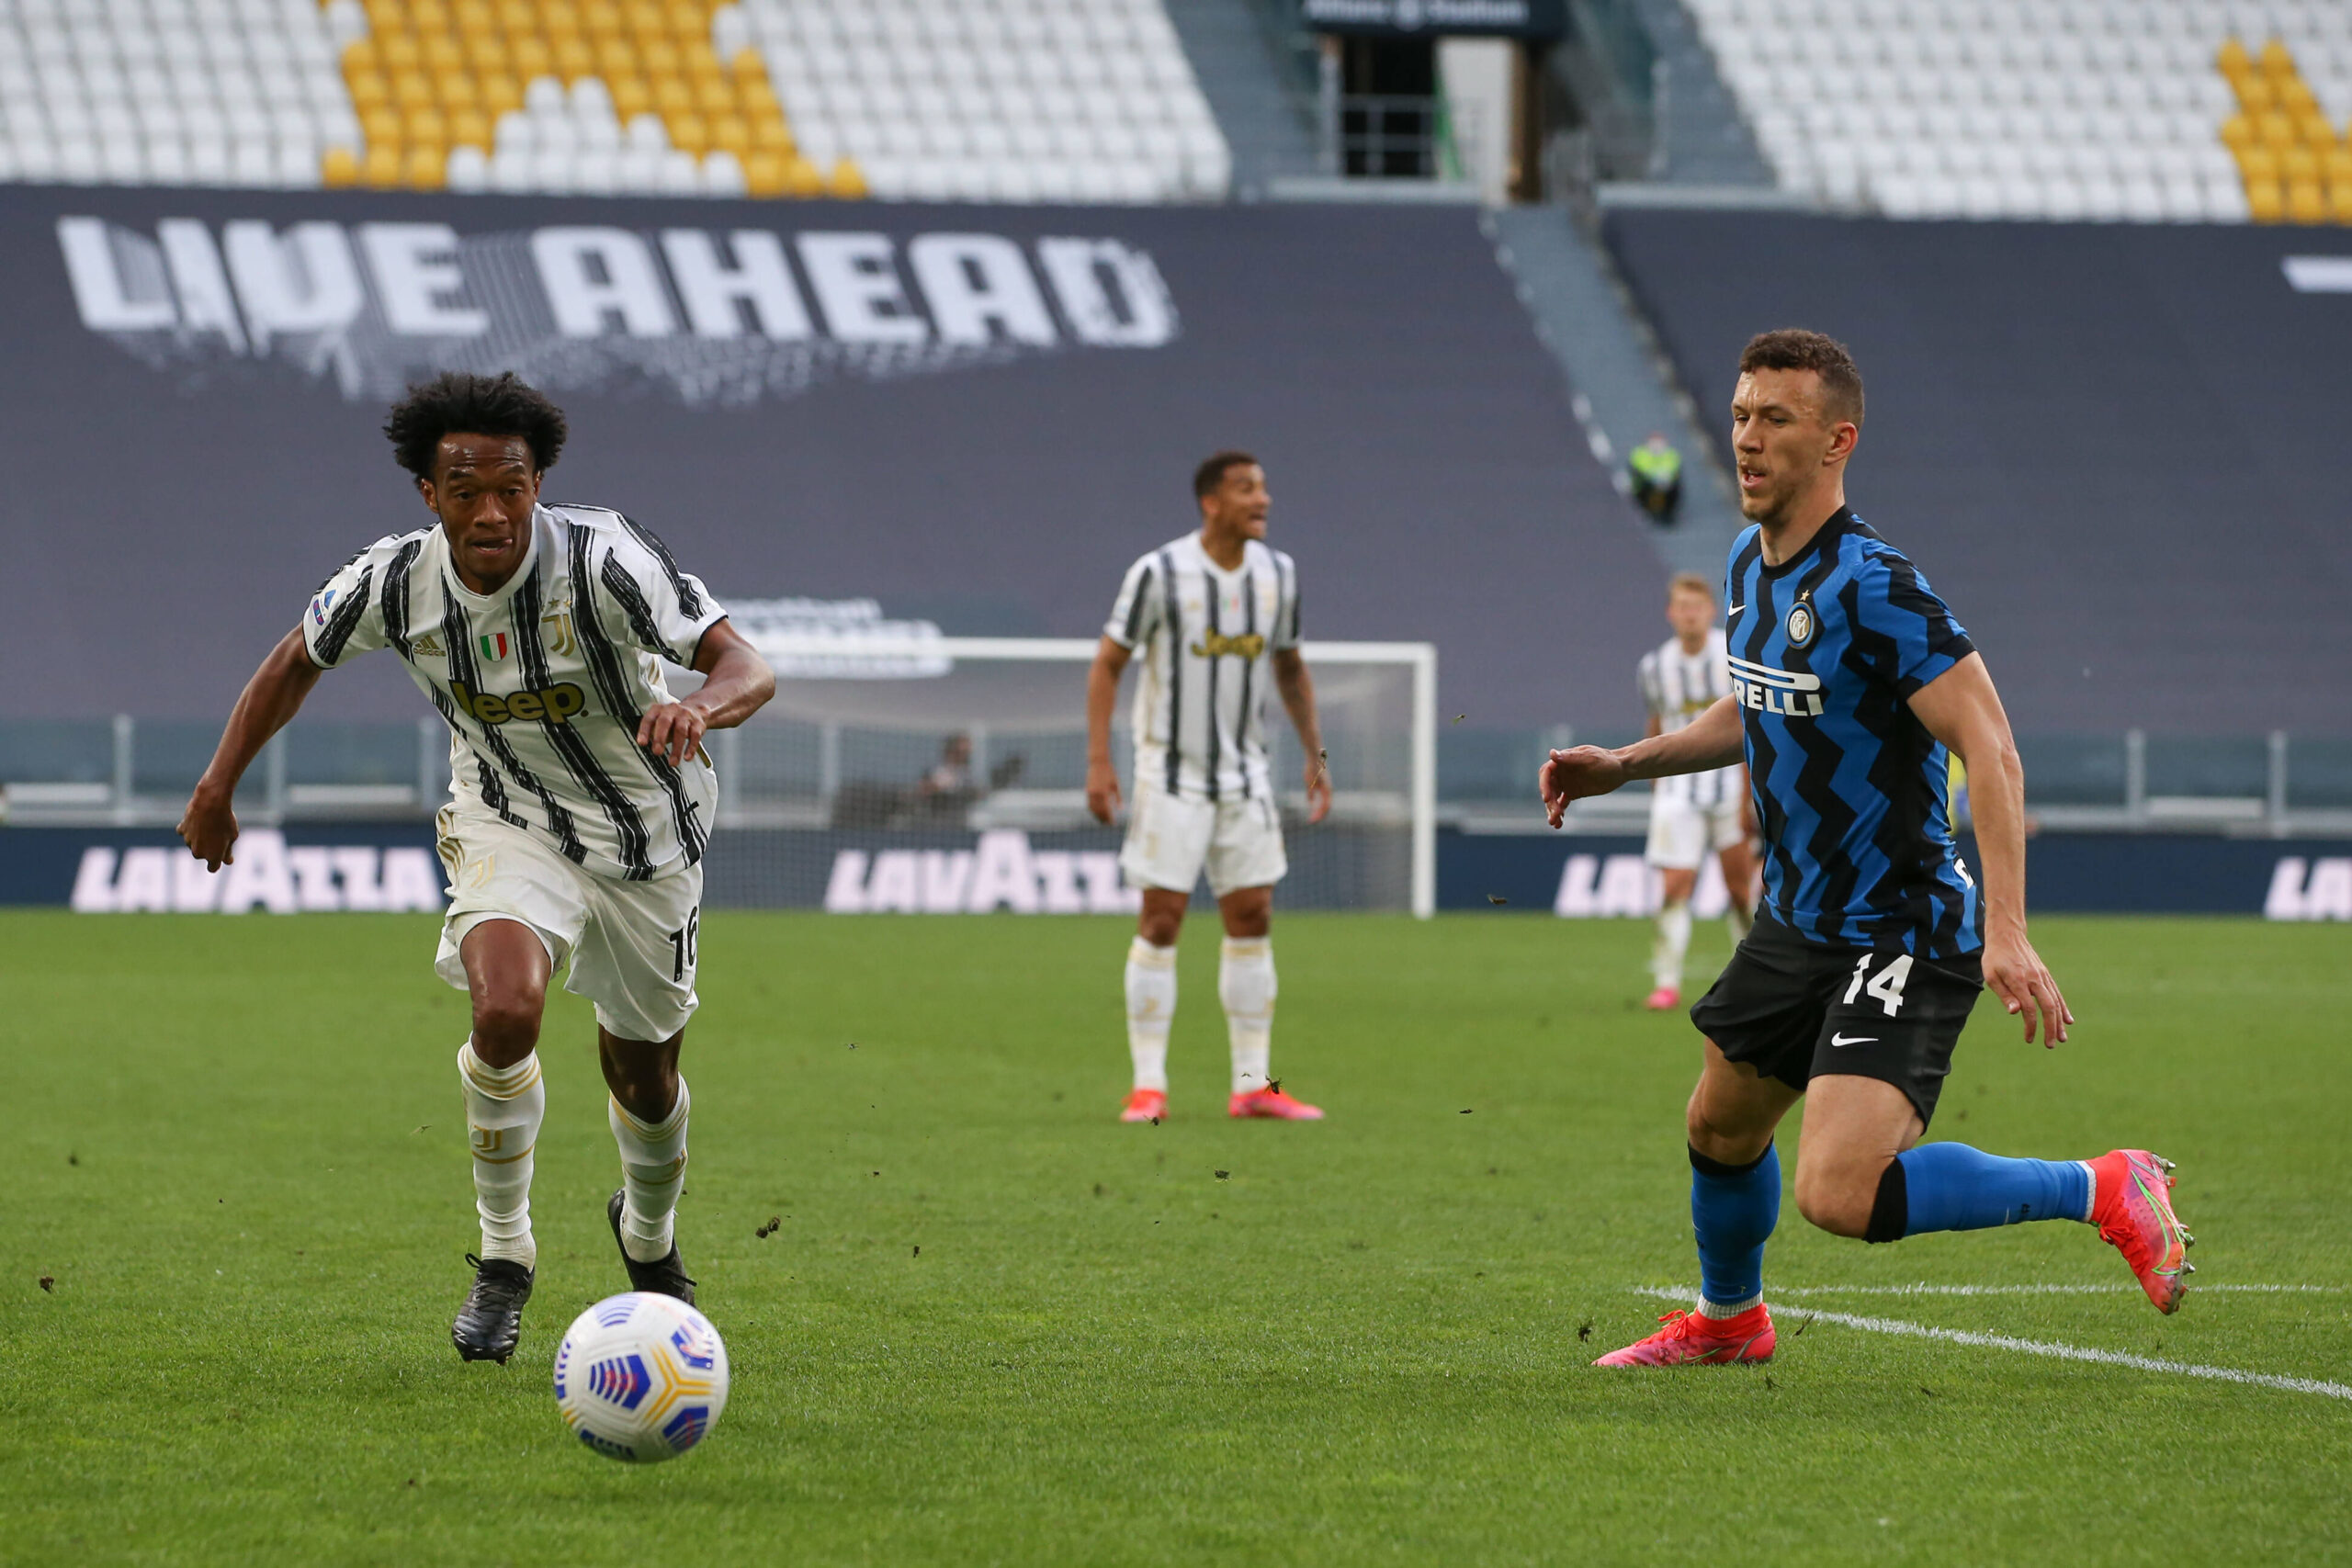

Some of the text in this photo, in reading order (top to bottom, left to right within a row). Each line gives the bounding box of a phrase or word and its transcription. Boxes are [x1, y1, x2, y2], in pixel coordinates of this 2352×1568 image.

[55, 216, 1182, 356] LIVE AHEAD
[413, 647, 447, 658] adidas
[448, 679, 585, 725] Jeep
[71, 828, 443, 914] LAVAZZA
[824, 829, 1143, 914] LAVAZZ
[1843, 953, 1914, 1018] 14
